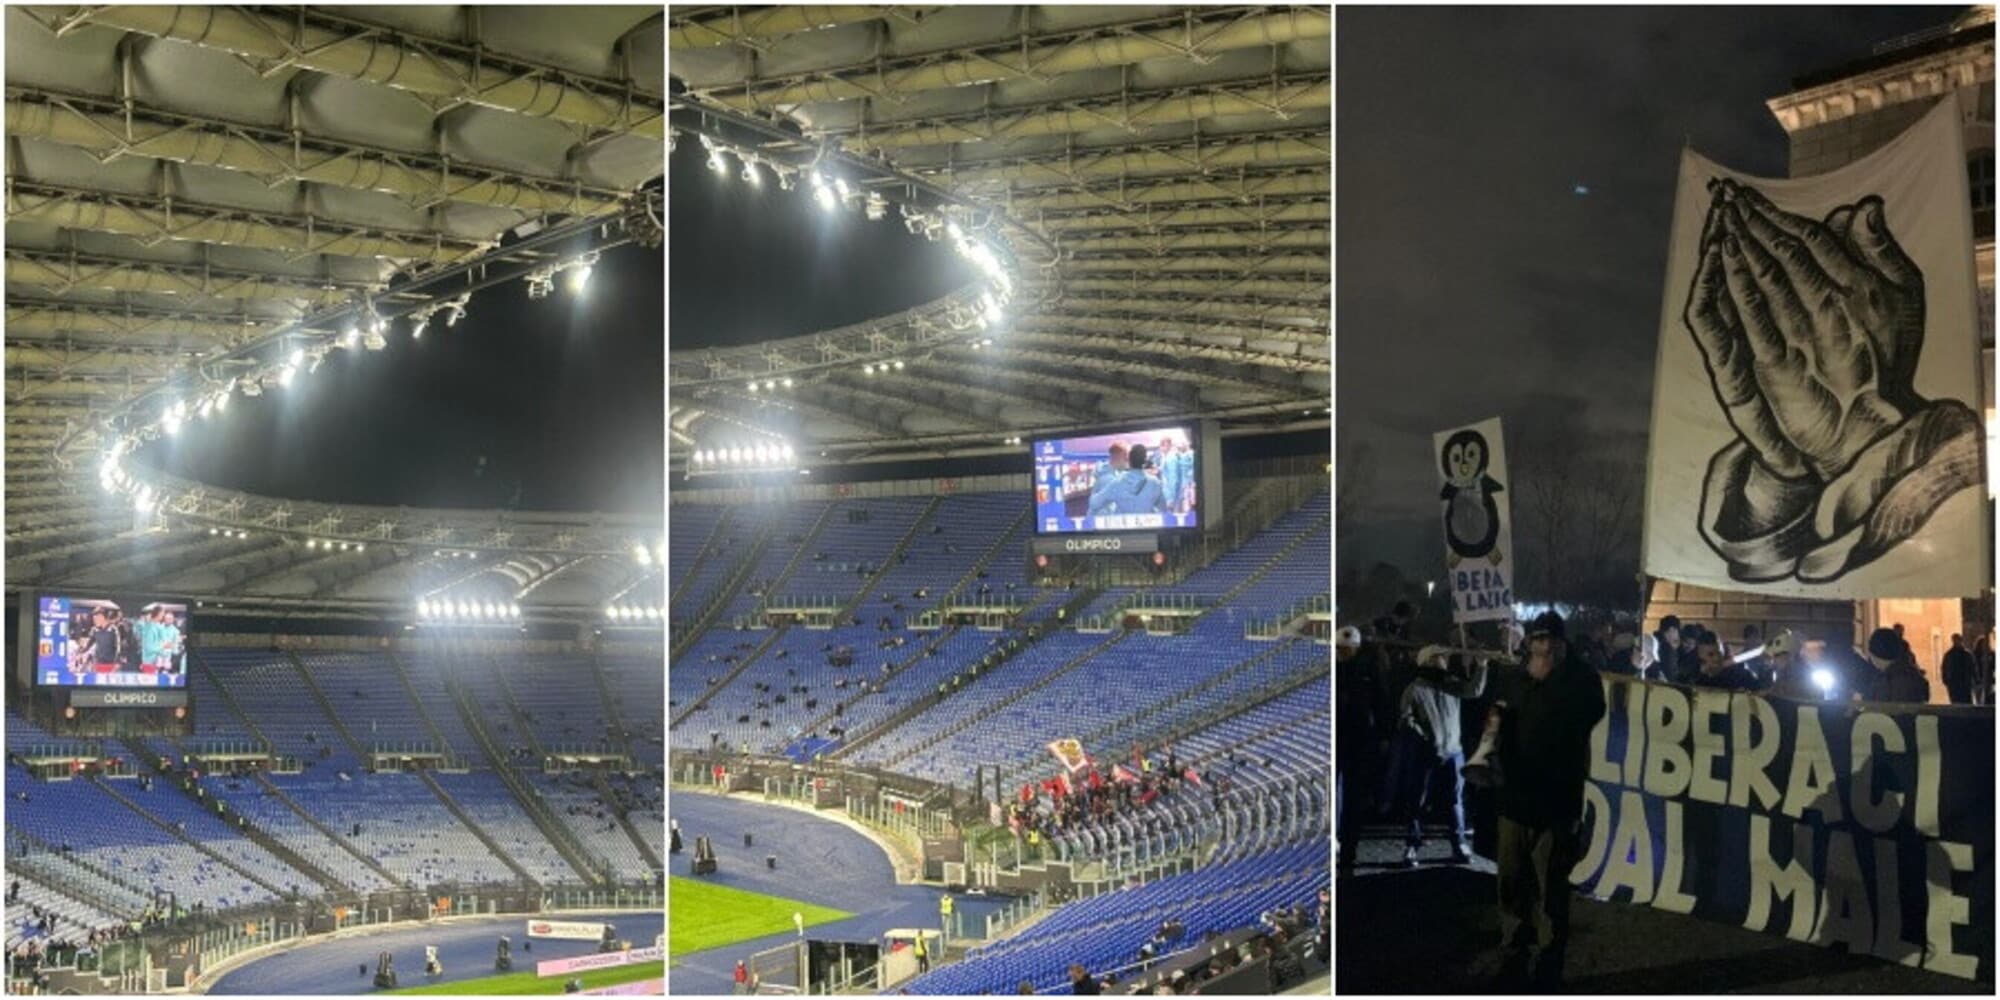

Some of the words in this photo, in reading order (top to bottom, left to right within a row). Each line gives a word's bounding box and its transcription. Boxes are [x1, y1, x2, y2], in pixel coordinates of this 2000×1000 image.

[1065, 538, 1121, 551] OLIMPICO
[103, 691, 157, 704] OLIMPICO
[1591, 679, 1941, 836] LIBERACI
[1568, 780, 1696, 914] DAL
[1743, 815, 1979, 980] MALE
